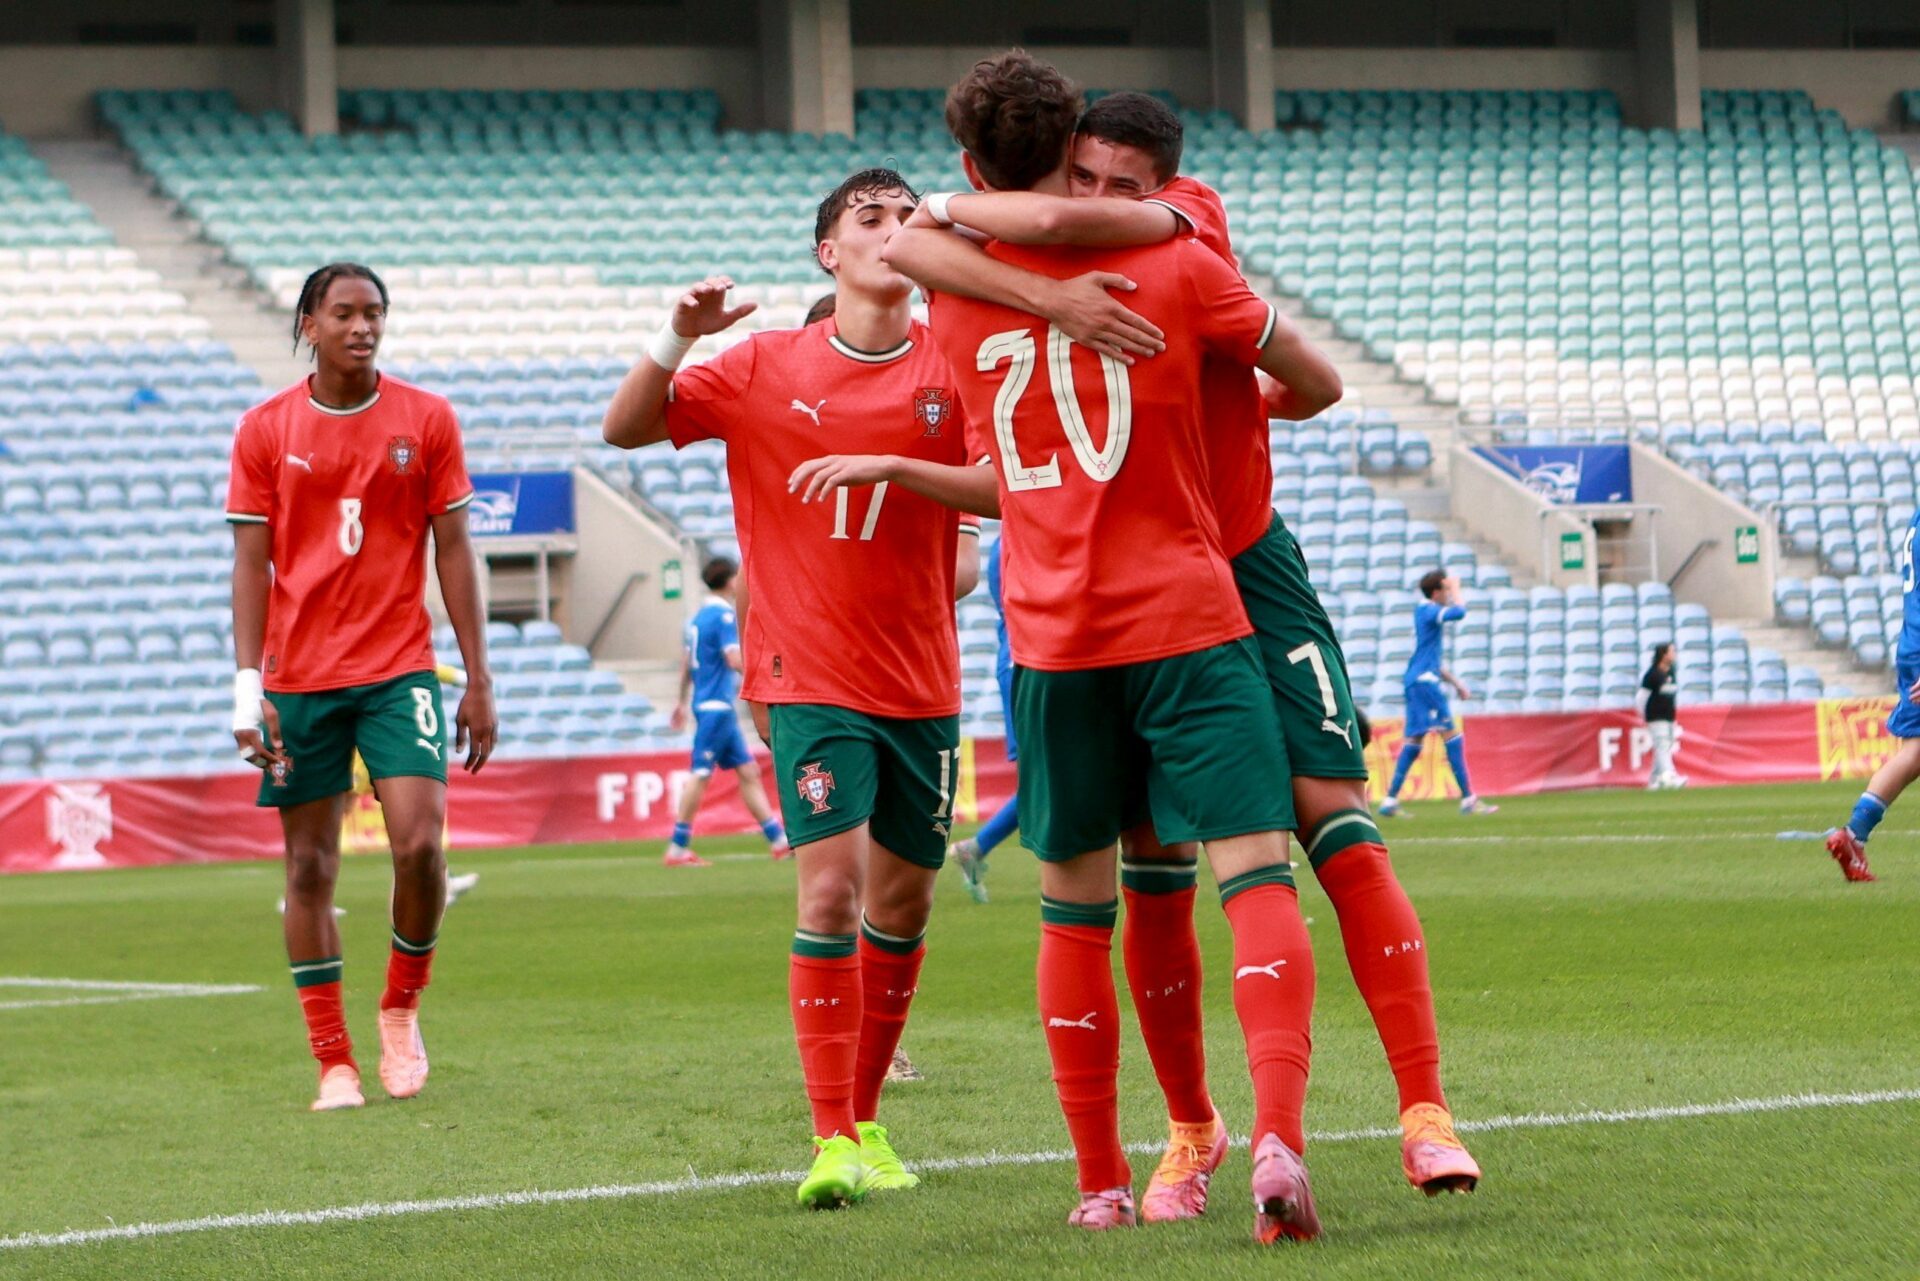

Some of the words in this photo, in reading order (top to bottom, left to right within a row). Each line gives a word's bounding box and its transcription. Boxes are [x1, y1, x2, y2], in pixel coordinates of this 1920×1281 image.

[976, 322, 1132, 492] 20
[338, 497, 364, 557] 8
[829, 480, 889, 541] 17
[411, 686, 438, 737] 8
[1286, 641, 1338, 718] 7
[932, 746, 960, 818] 1
